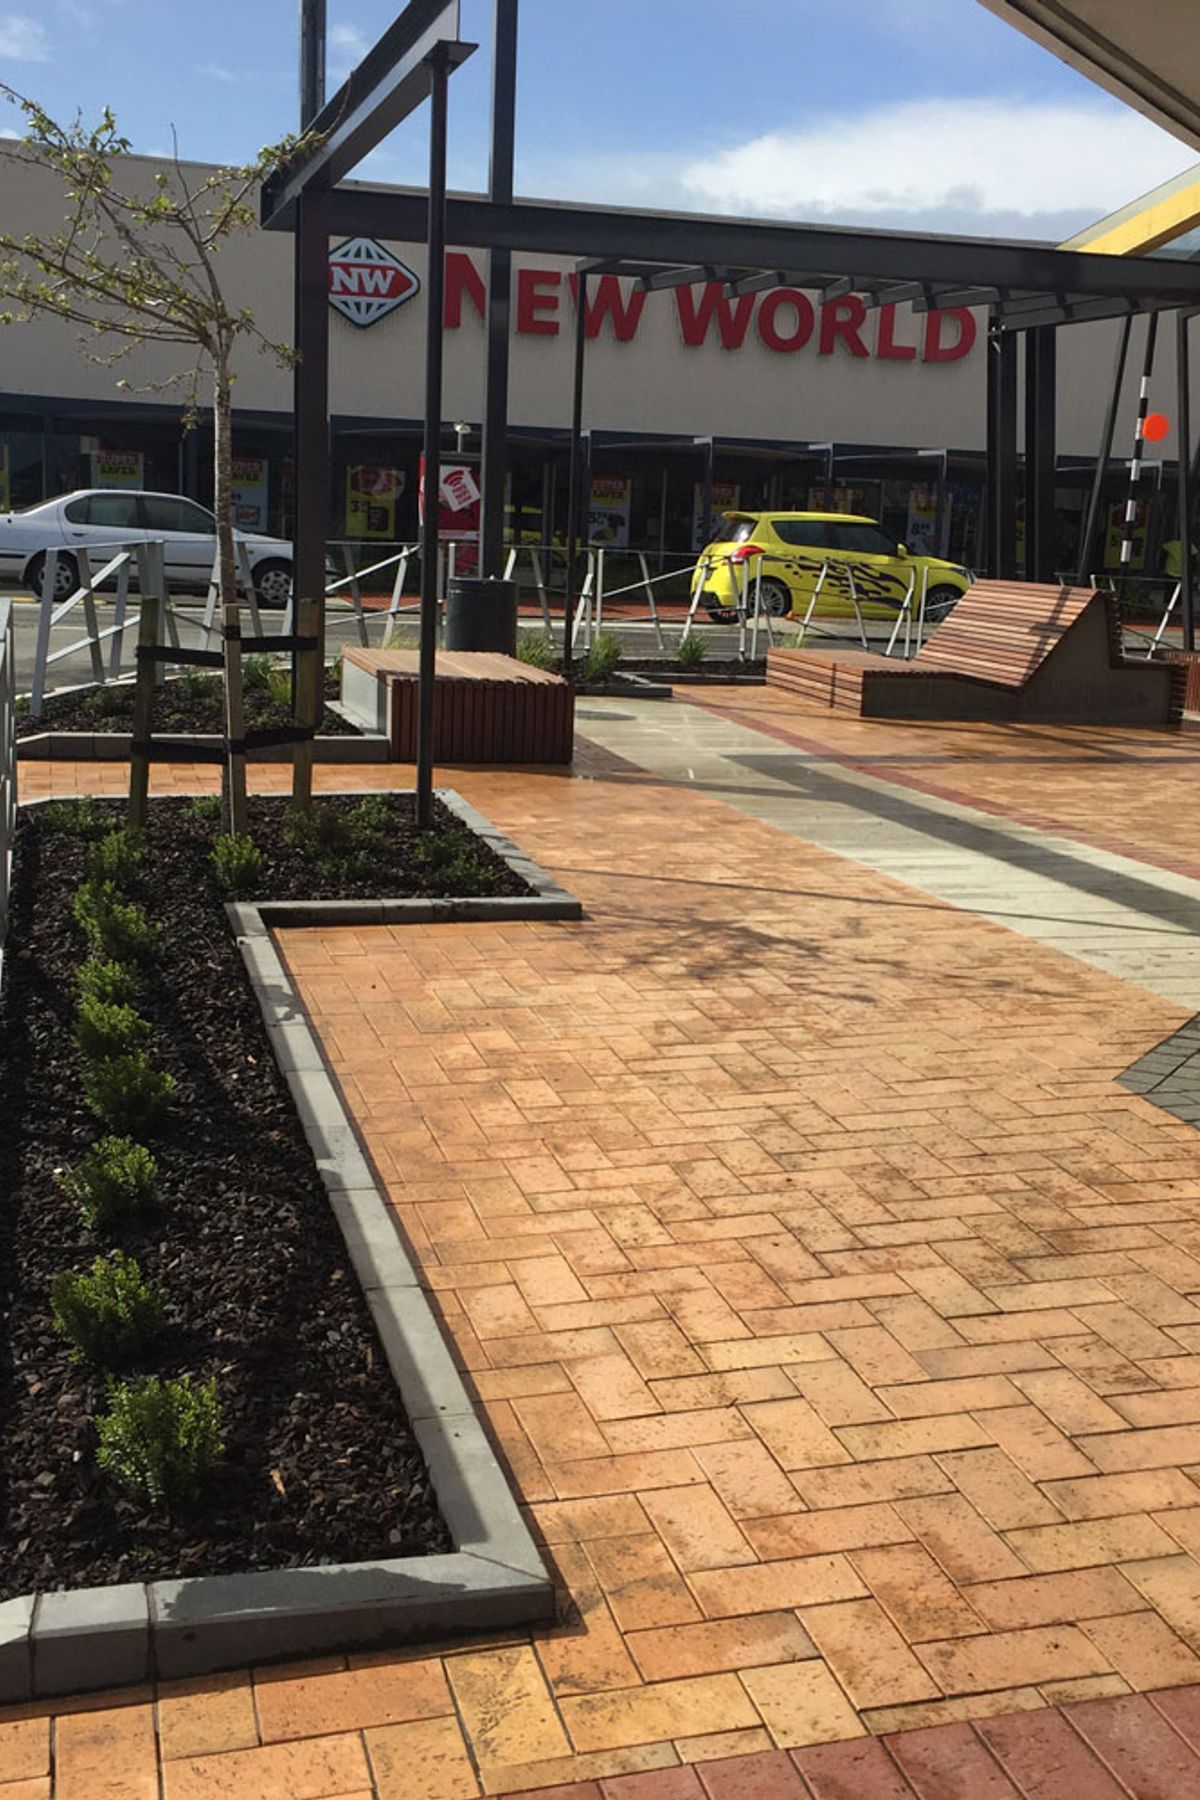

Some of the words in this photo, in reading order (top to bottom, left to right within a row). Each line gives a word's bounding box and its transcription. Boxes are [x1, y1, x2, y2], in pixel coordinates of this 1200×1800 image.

[330, 266, 395, 295] NW
[443, 251, 648, 341] NEW
[673, 279, 977, 362] WORLD
